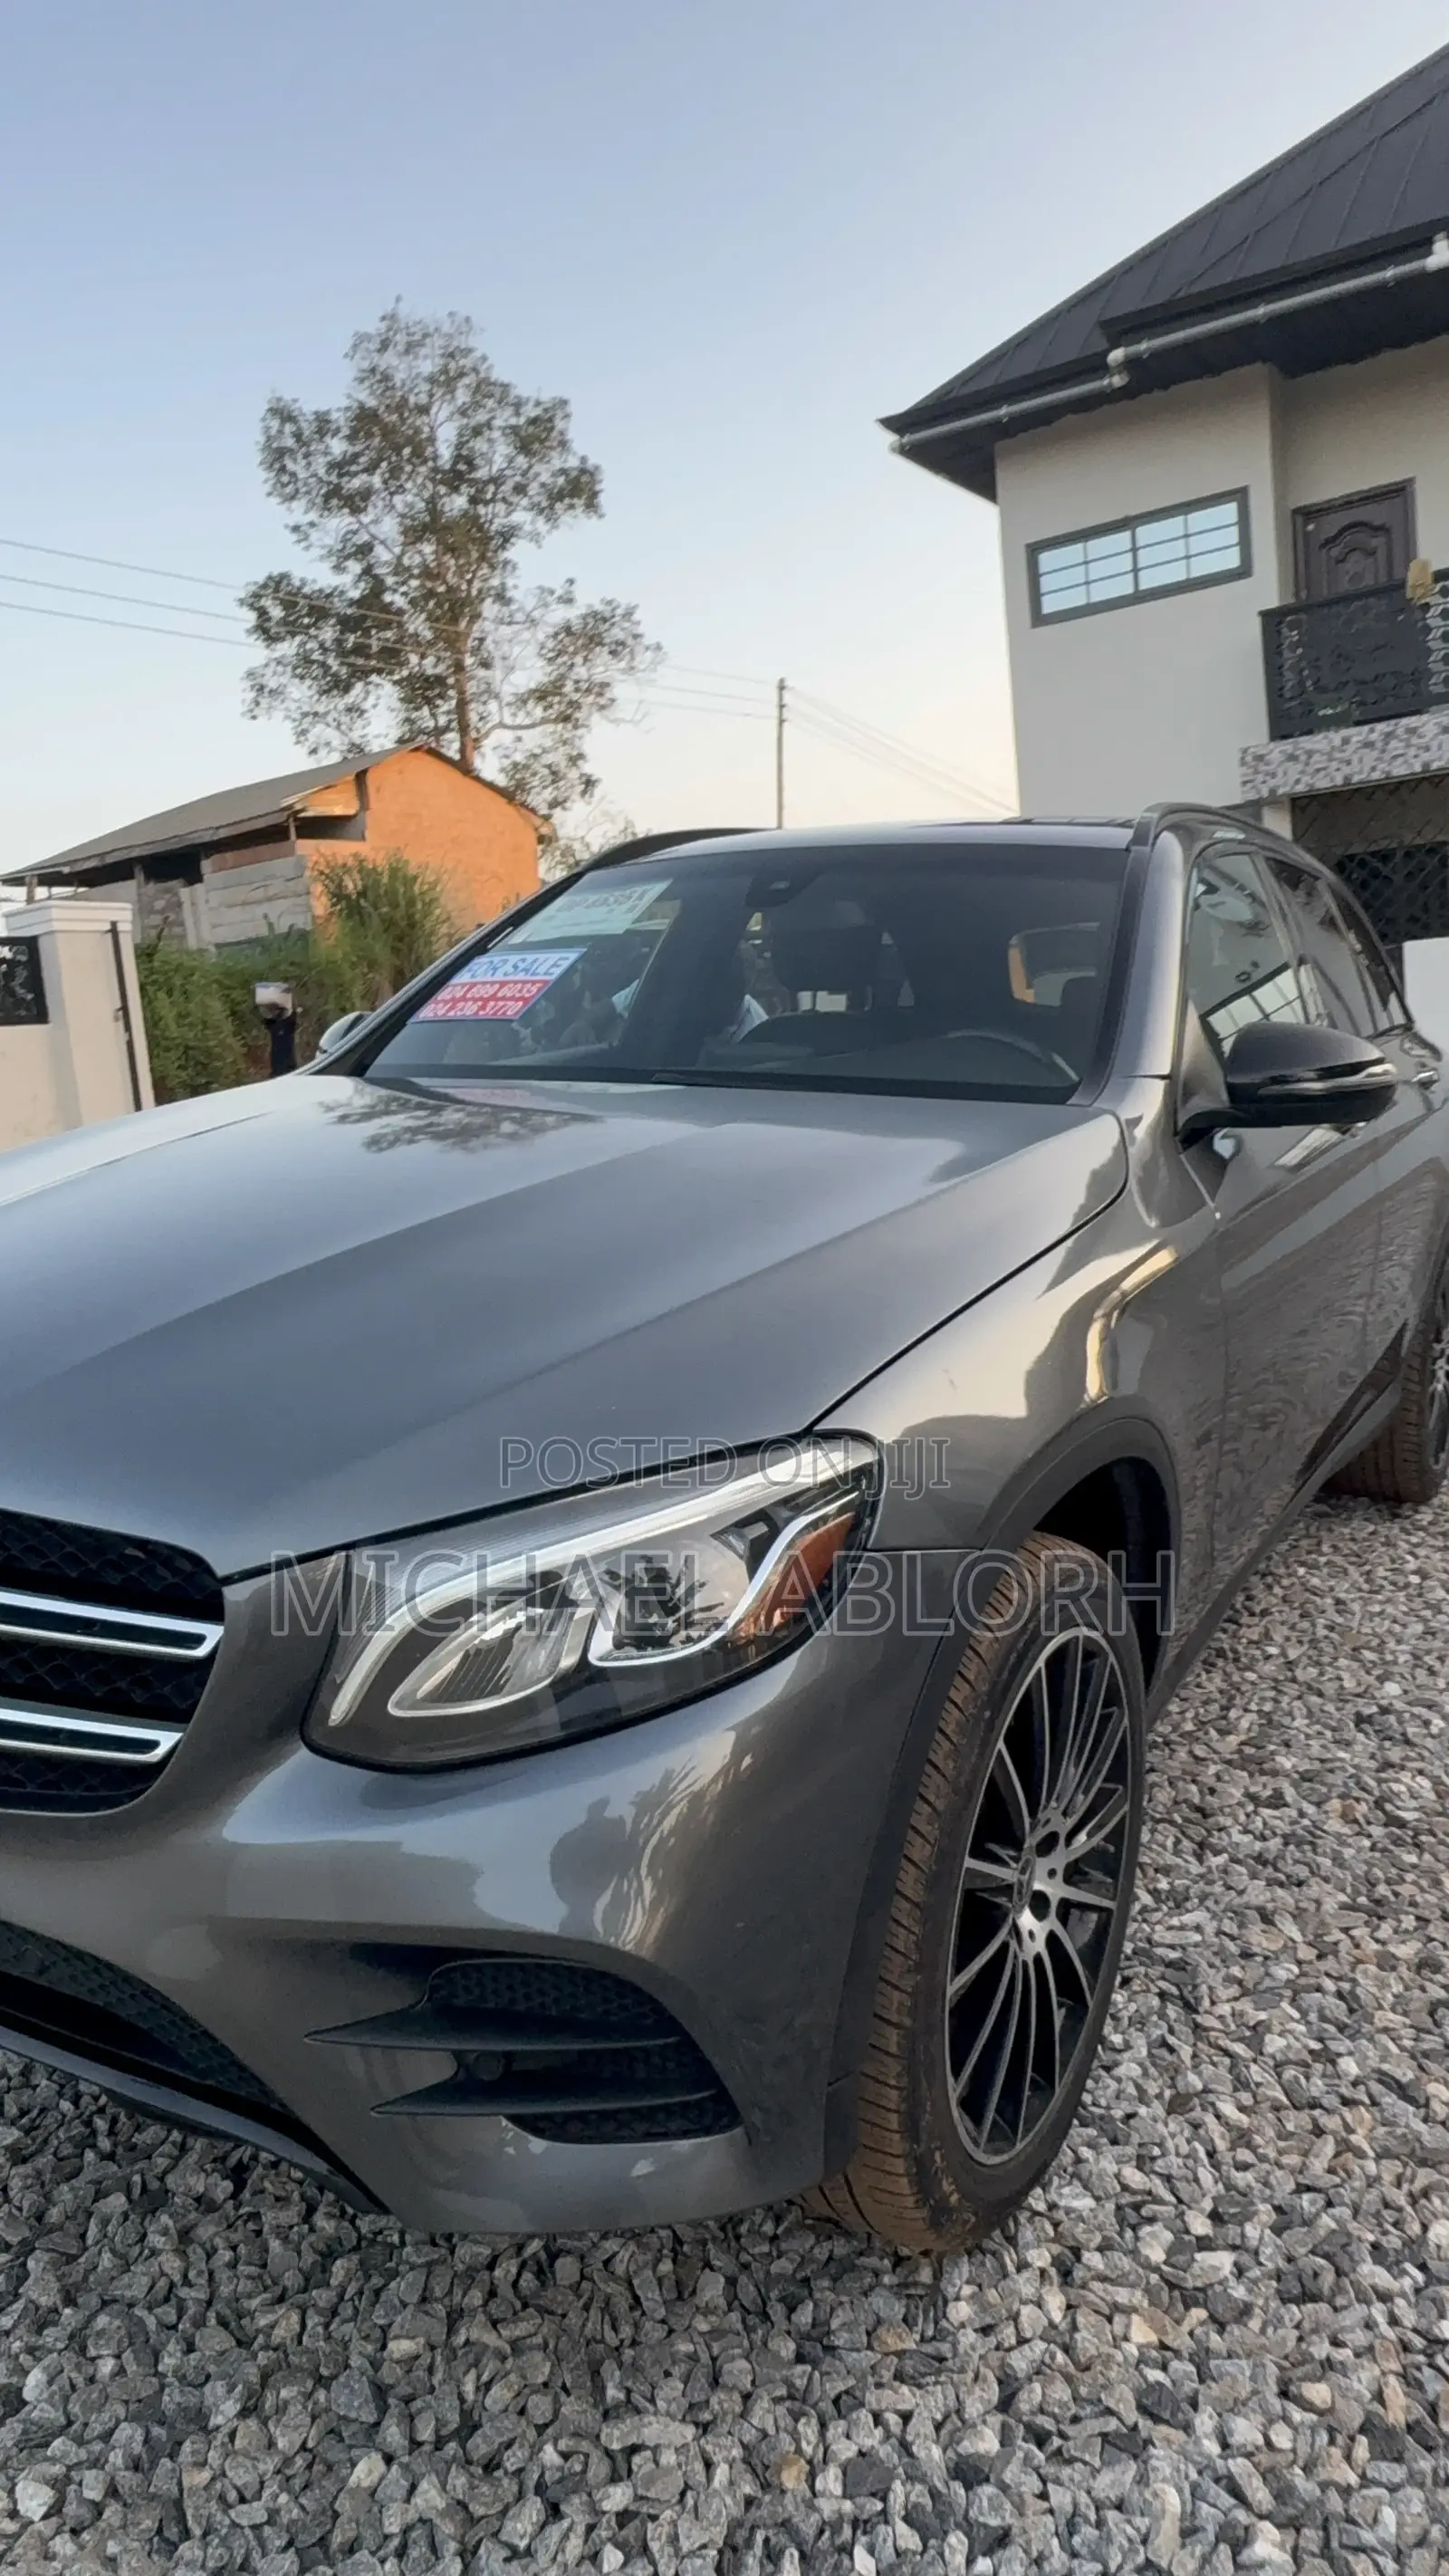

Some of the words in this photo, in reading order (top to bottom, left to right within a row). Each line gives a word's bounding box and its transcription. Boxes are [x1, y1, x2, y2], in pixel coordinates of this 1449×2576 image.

[458, 958, 509, 979] FOR
[505, 956, 569, 976] SALE
[478, 1001, 523, 1016] 3770
